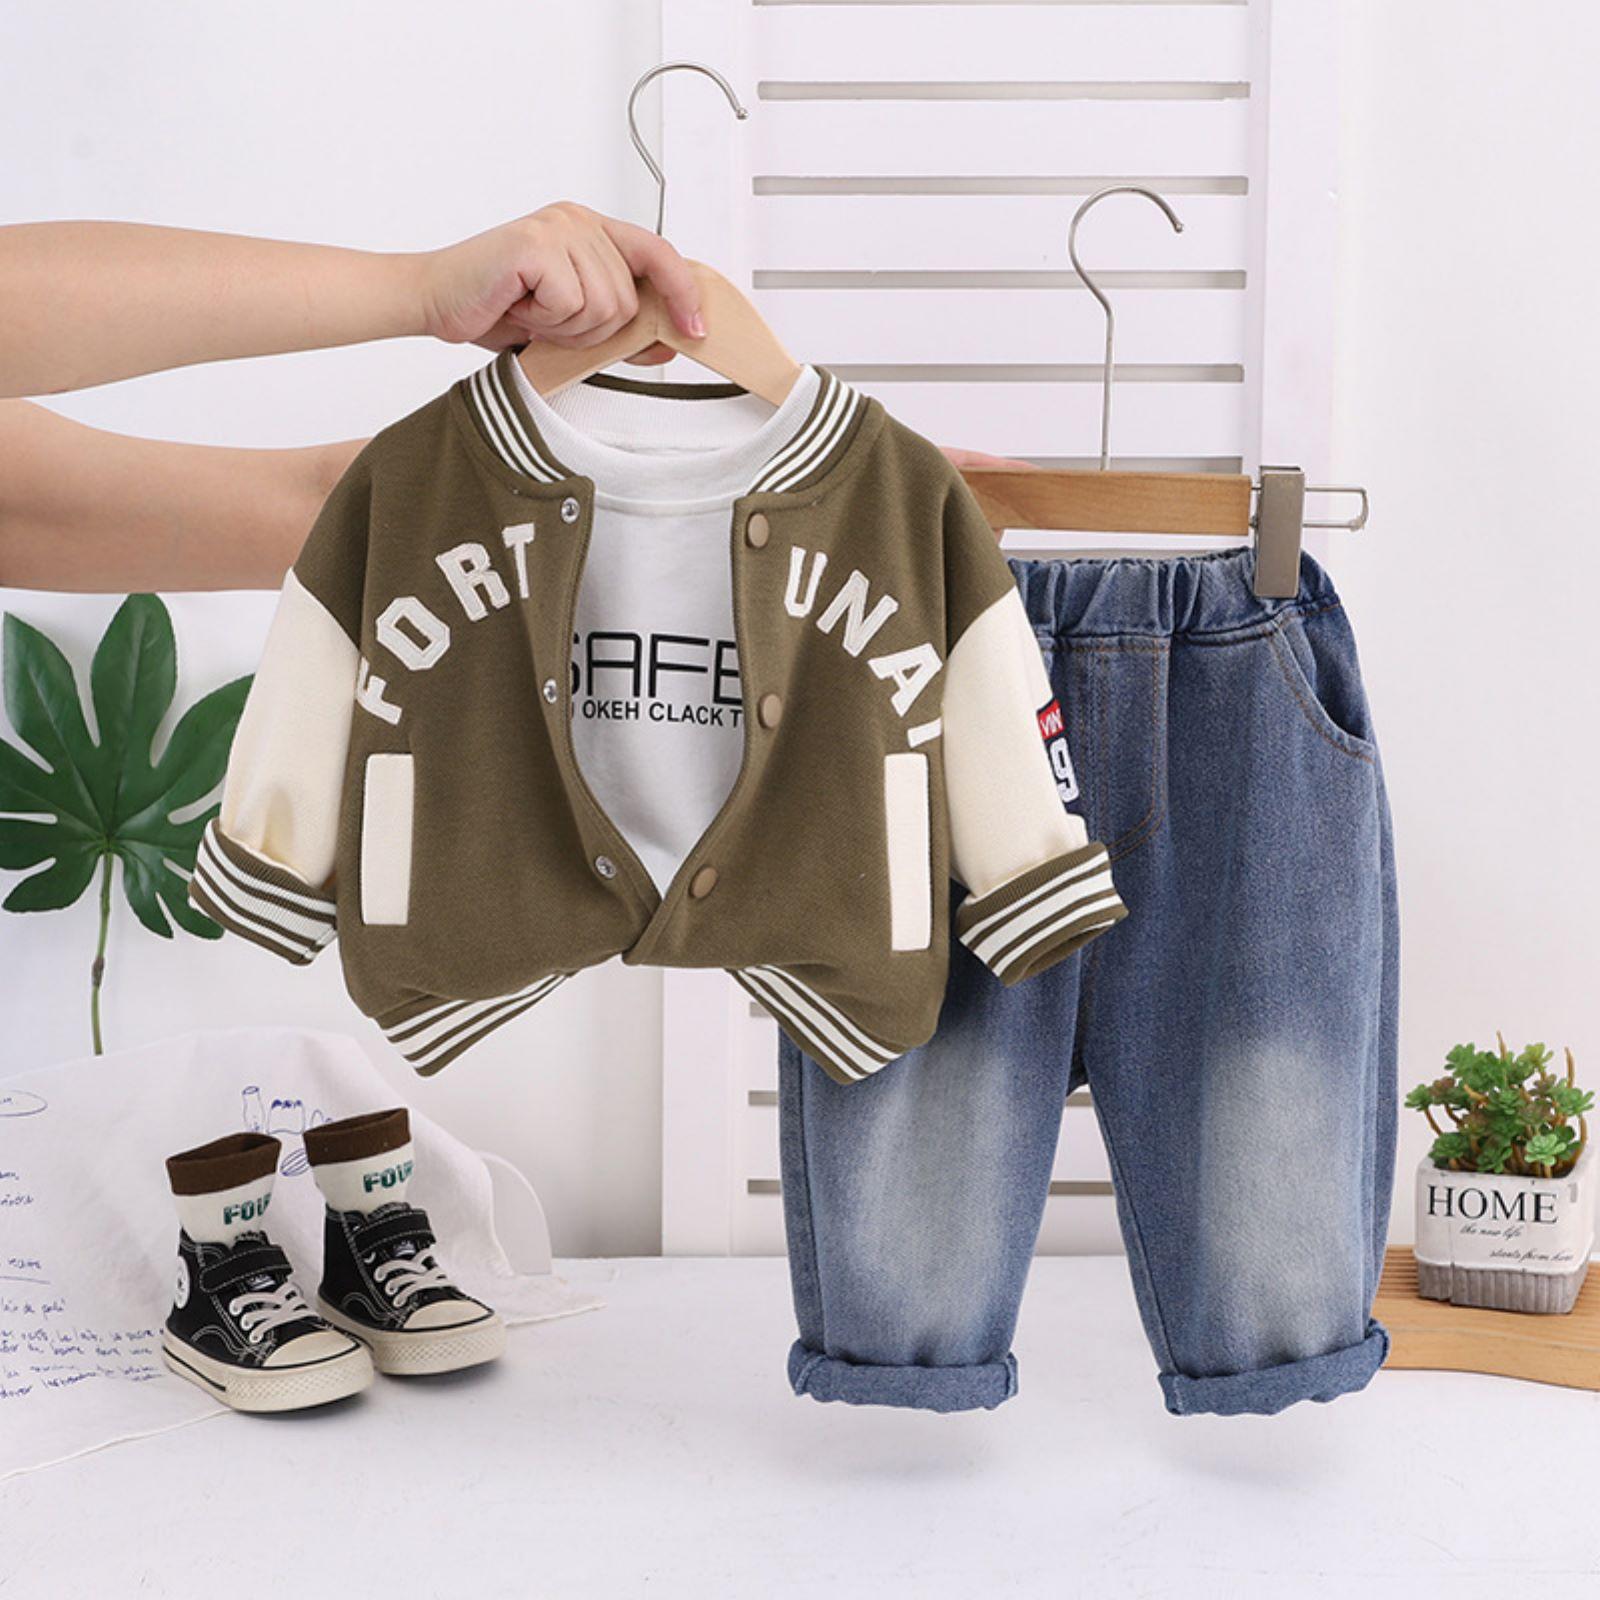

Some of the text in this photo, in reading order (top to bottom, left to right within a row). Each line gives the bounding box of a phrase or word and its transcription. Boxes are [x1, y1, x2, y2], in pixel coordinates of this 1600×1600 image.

[357, 522, 536, 726] FORT
[572, 631, 743, 705] AFE
[582, 699, 639, 720] OKEH
[648, 701, 723, 727] CLACK
[1427, 1184, 1559, 1224] HOME
